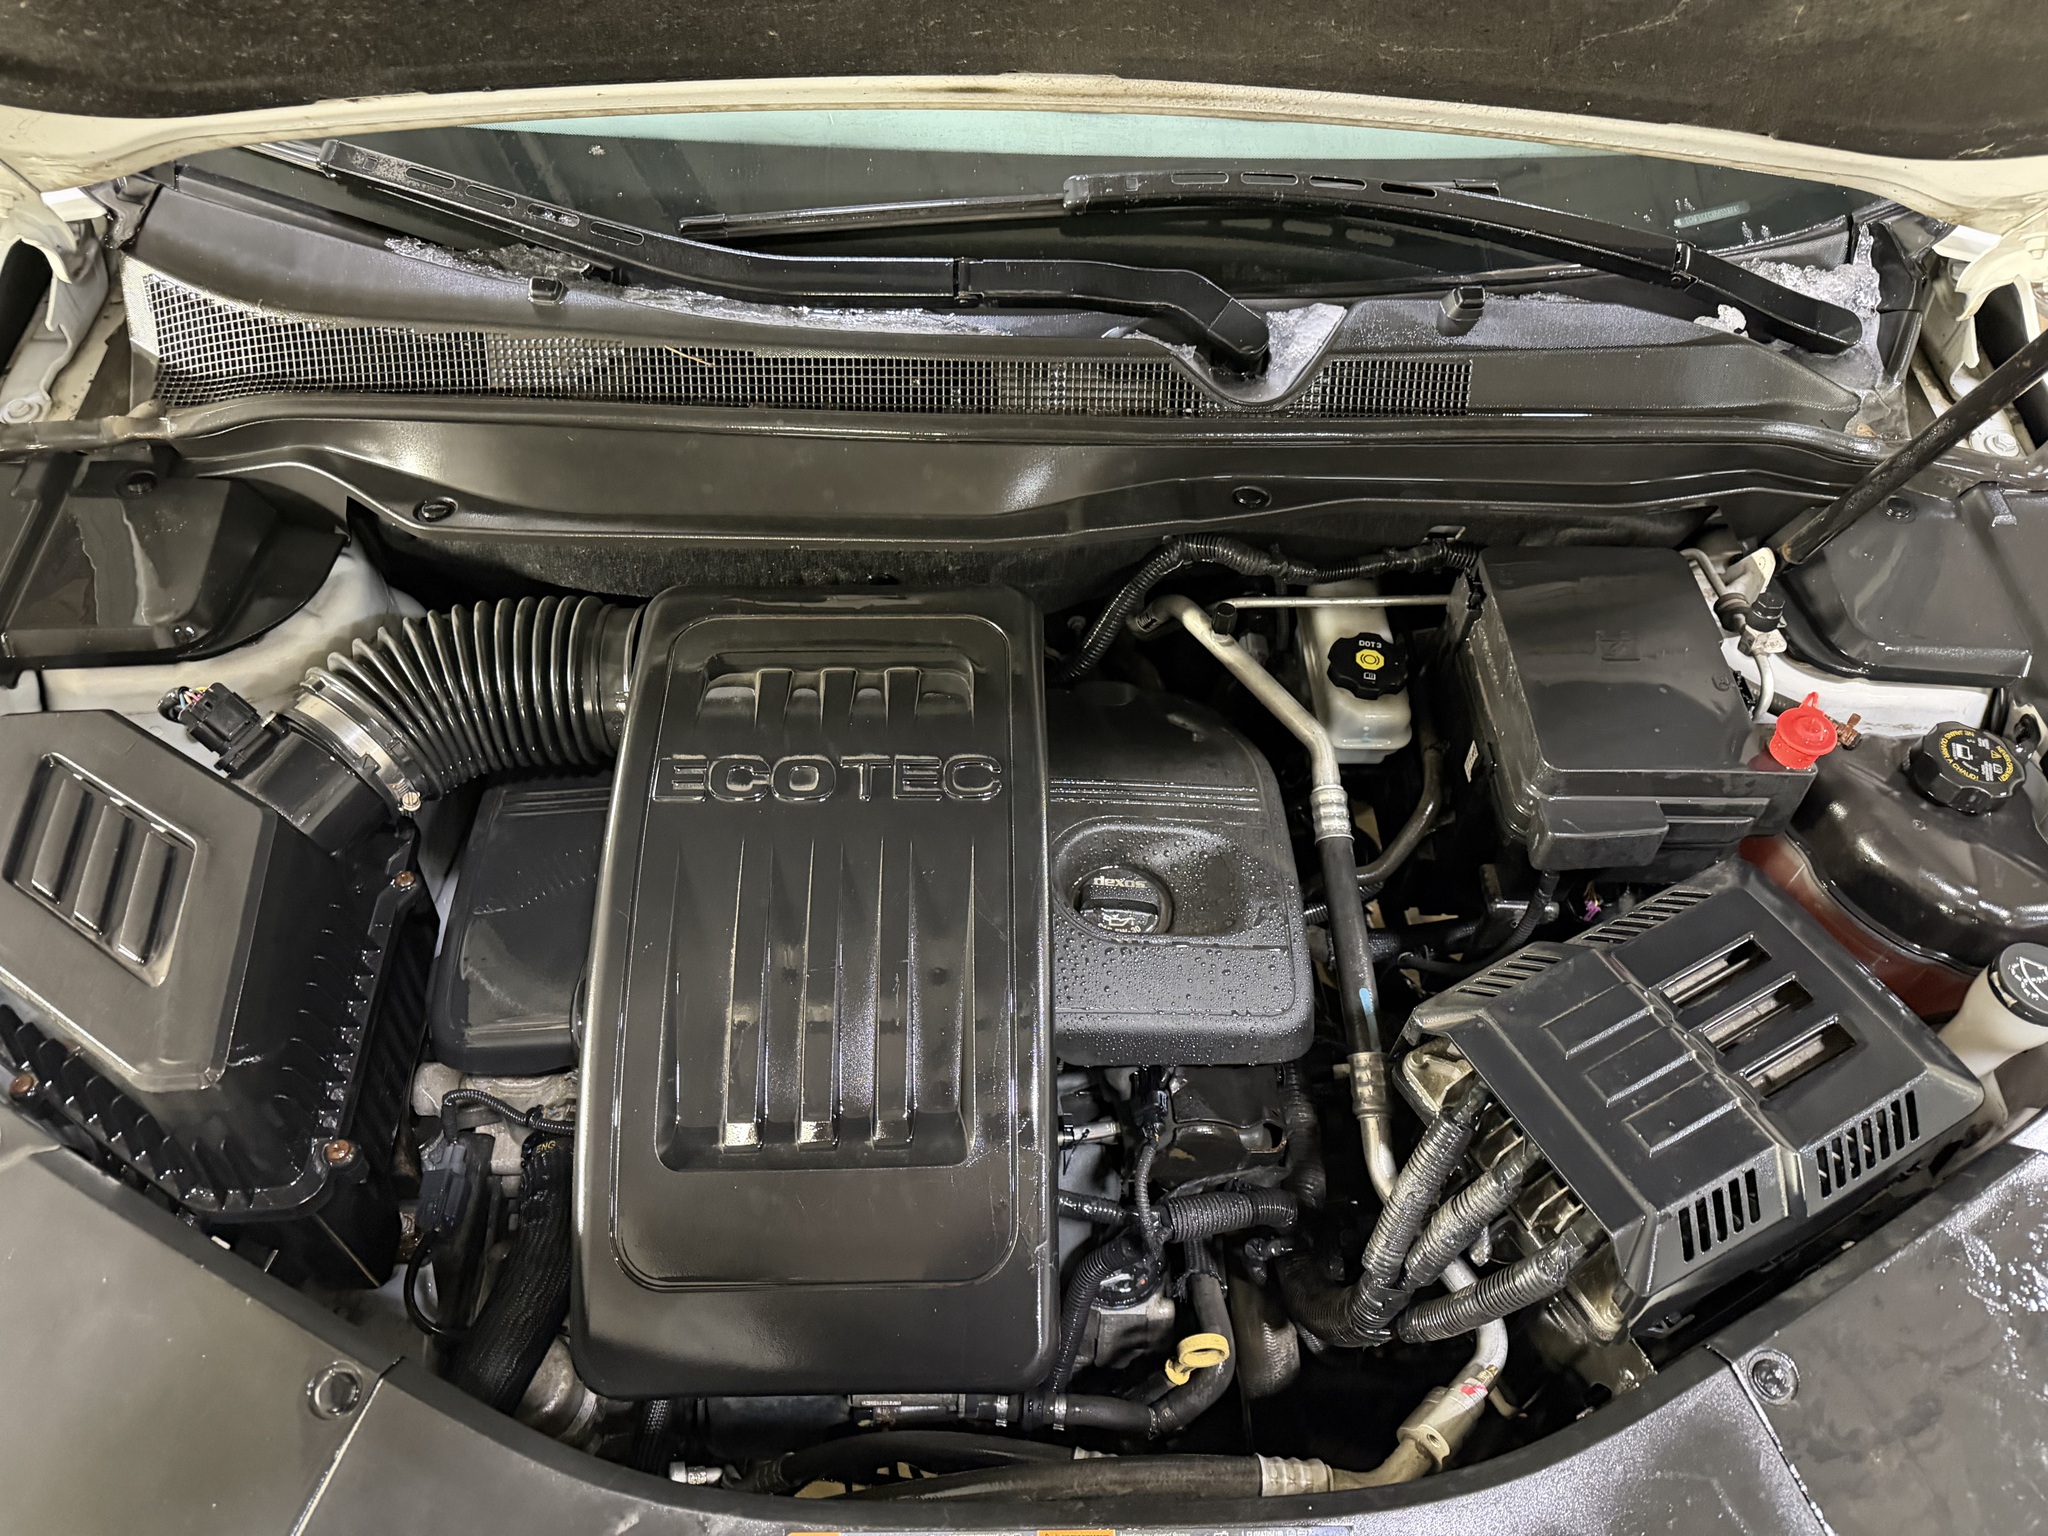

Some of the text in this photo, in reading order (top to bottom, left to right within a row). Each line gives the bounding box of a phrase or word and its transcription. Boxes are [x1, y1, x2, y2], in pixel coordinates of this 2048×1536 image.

[1358, 640, 1376, 648] DOT
[652, 753, 1002, 802] ECOTEC
[1093, 875, 1146, 888] dexos
[535, 1140, 556, 1153] ENG
